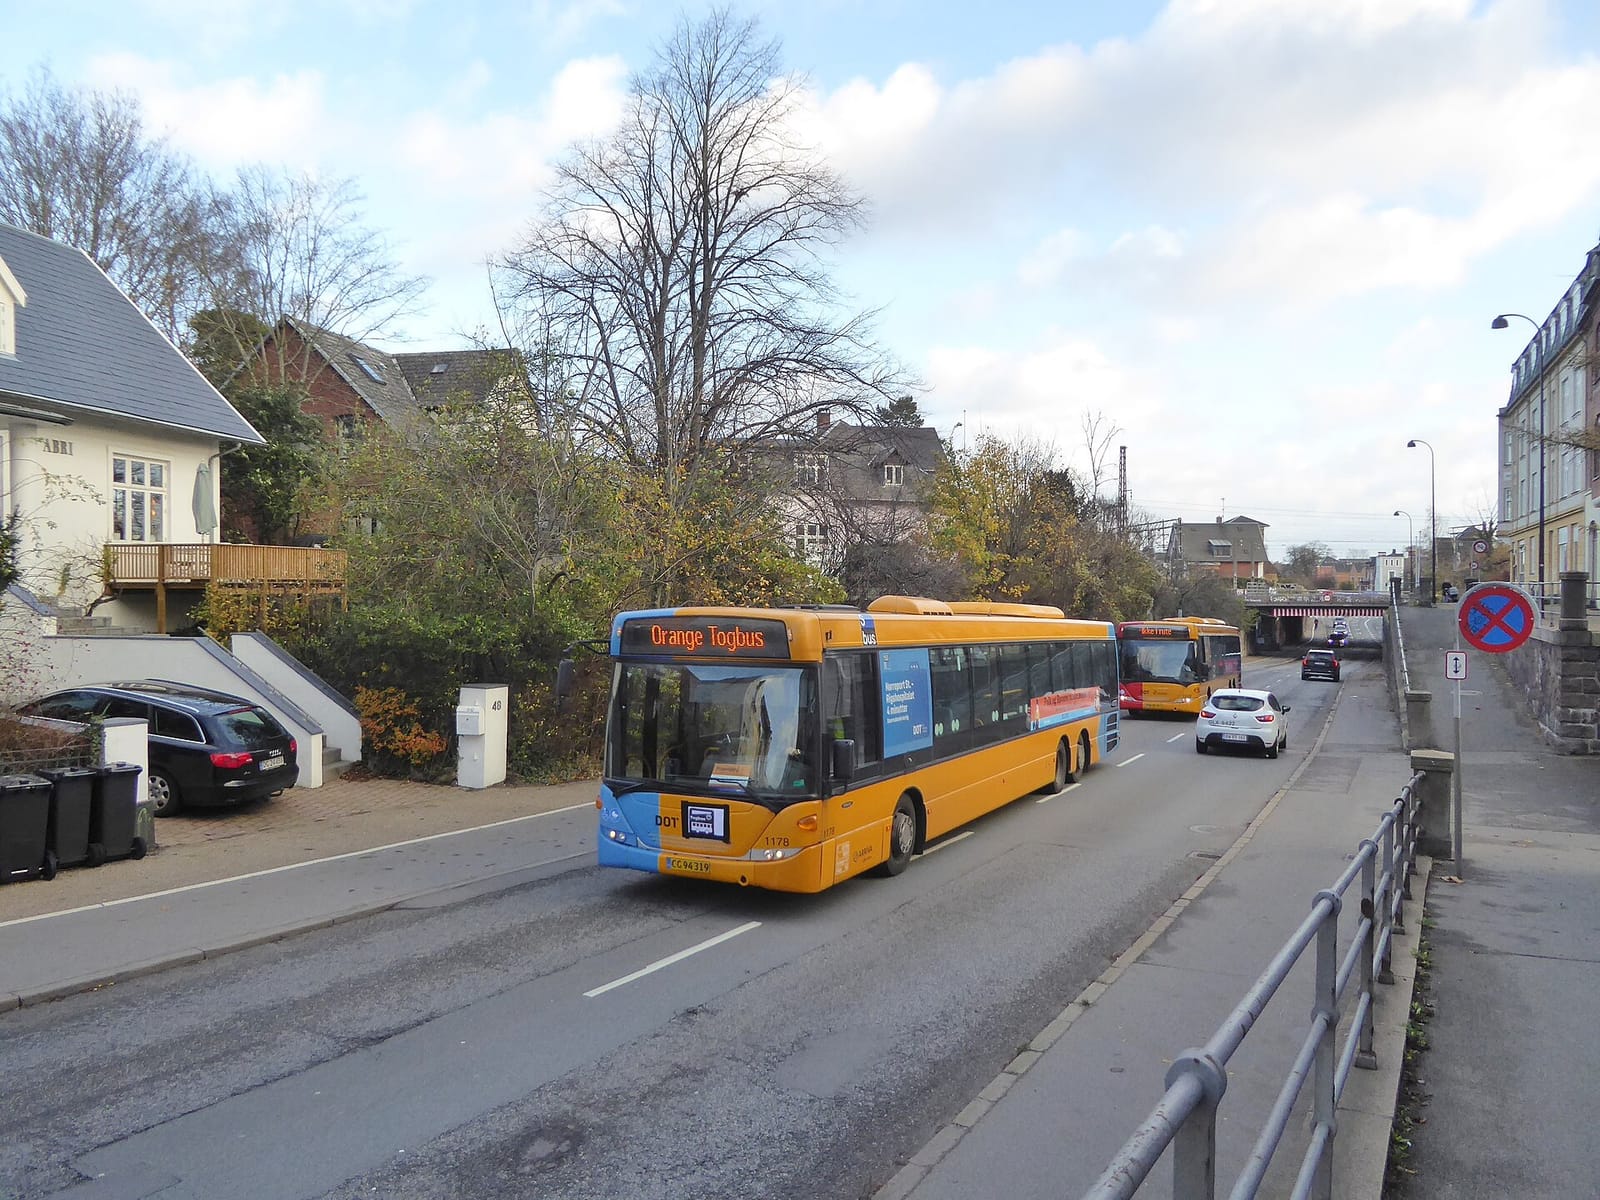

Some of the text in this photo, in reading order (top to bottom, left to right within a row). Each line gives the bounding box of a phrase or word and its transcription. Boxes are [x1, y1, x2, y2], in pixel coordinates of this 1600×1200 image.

[43, 438, 73, 456] ABRI
[651, 624, 764, 652] Orange Togbus
[862, 631, 877, 645] bus
[491, 700, 502, 711] 48
[655, 815, 679, 828] DOT
[765, 836, 790, 847] 1178
